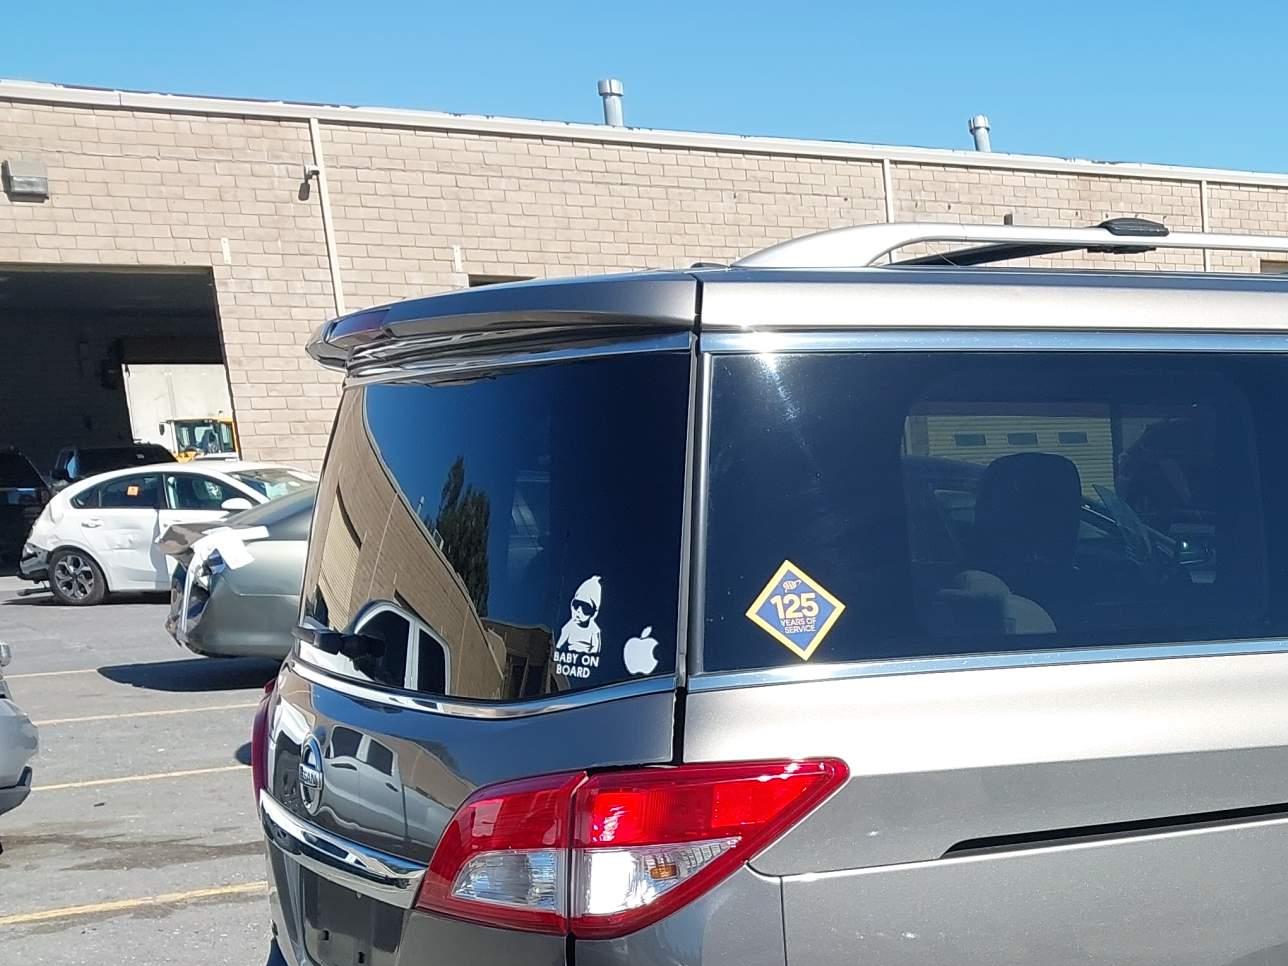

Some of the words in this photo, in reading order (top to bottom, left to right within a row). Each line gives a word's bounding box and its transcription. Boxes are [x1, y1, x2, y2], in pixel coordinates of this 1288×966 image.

[769, 592, 820, 620] 125
[780, 617, 806, 628] YEARS
[805, 616, 817, 626] OF
[784, 624, 817, 634] SERVICE
[553, 651, 579, 665] BABY
[581, 655, 600, 668] ON
[556, 663, 591, 679] BOARD
